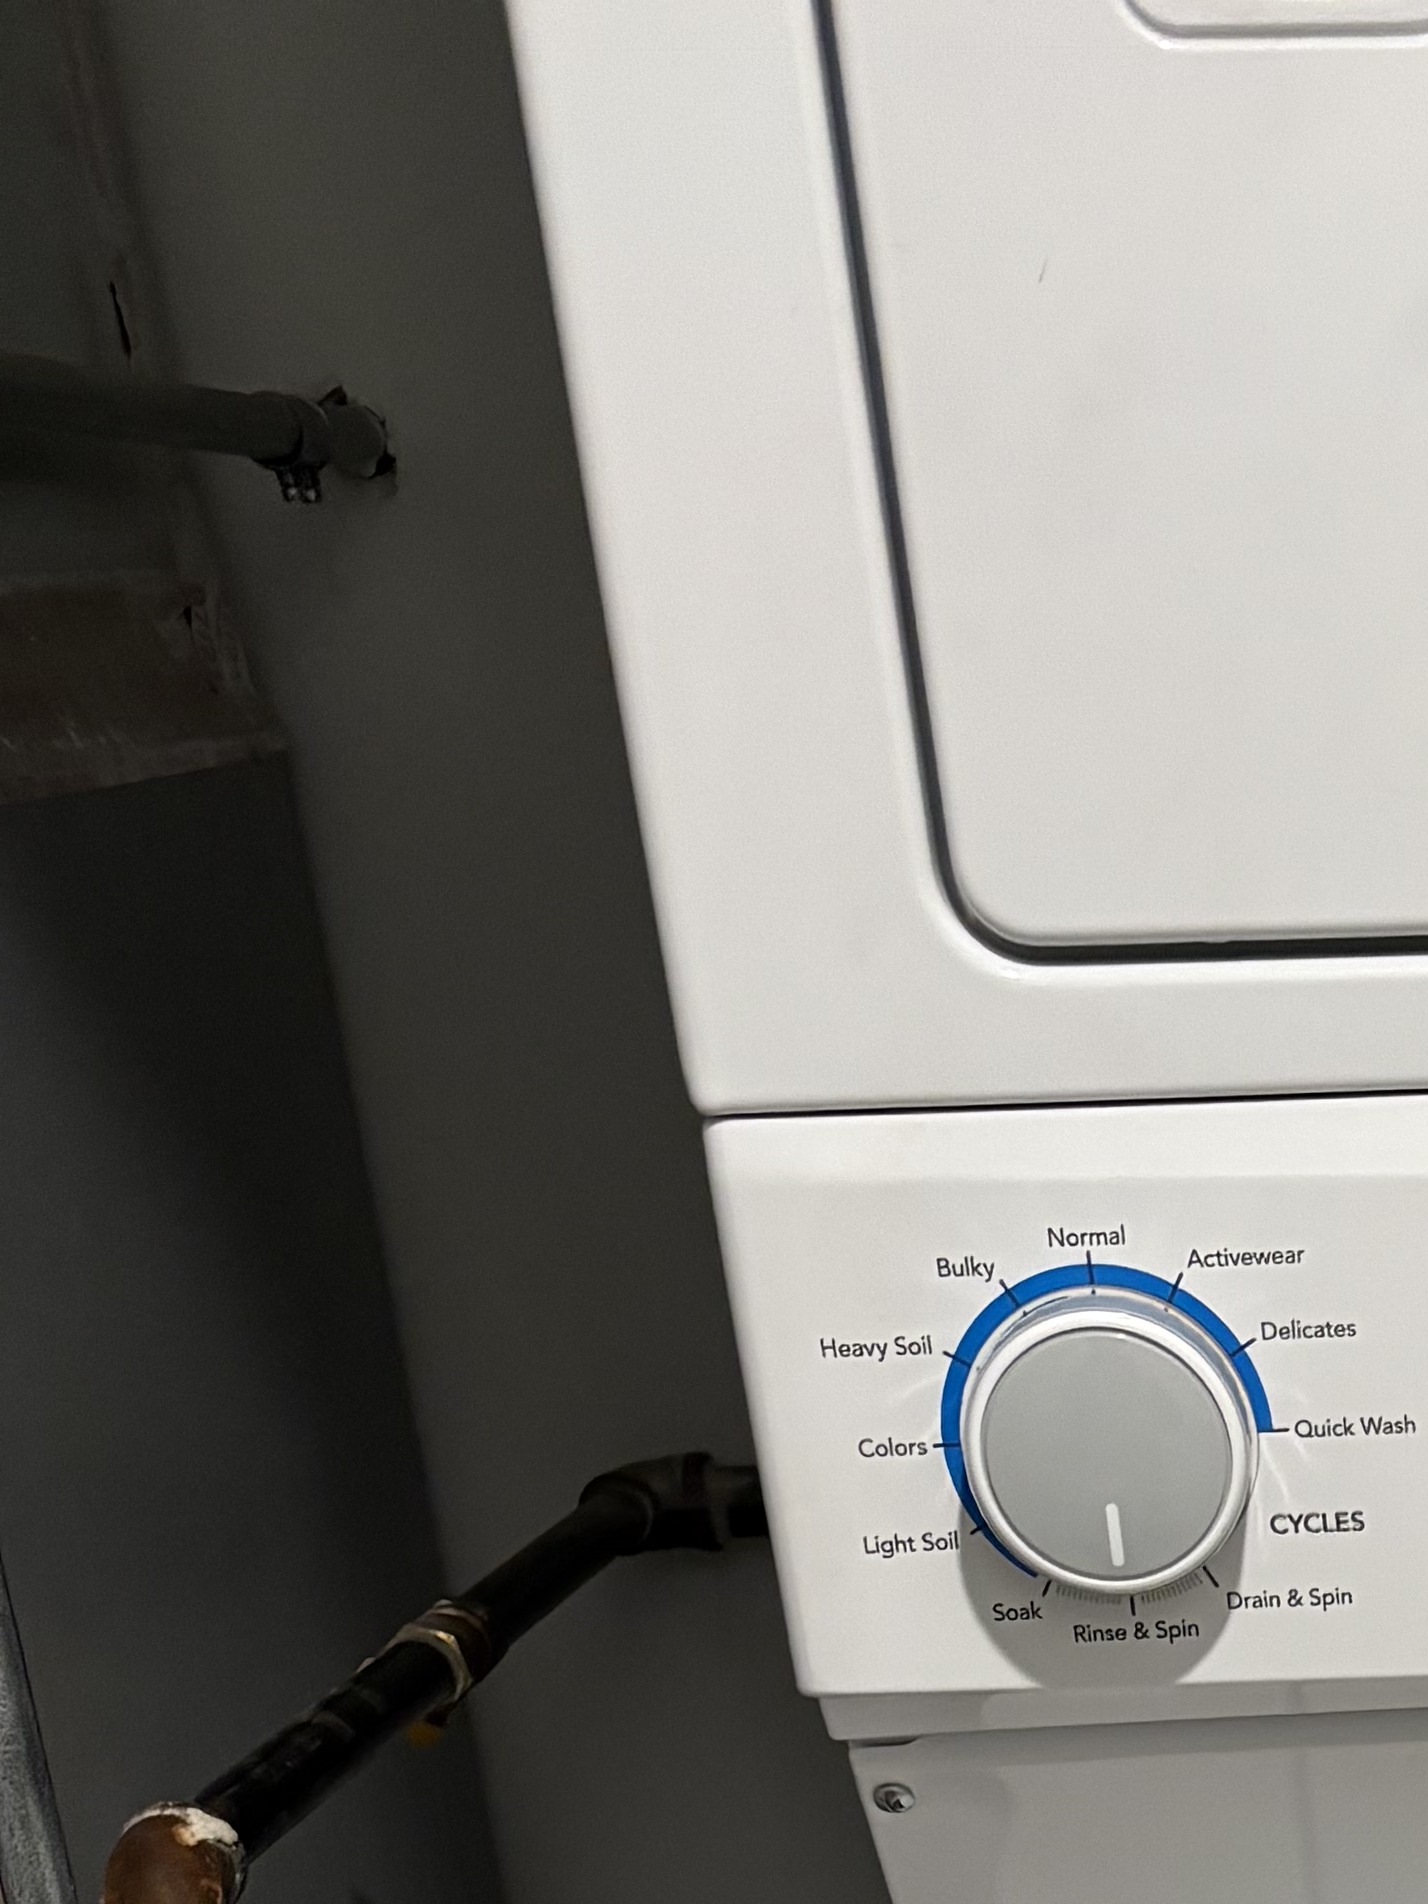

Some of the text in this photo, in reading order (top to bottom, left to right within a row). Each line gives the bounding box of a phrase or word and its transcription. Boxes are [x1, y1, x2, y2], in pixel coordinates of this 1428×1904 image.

[1047, 1226, 1125, 1247] Normal
[1187, 1248, 1305, 1269] Activewear
[936, 1258, 995, 1282] Bulky
[1261, 1321, 1357, 1342] Delicates
[820, 1336, 932, 1361] Heavy Soil
[1295, 1416, 1416, 1438] Quick Wash
[858, 1438, 928, 1458] Colors
[1270, 1512, 1365, 1535] CYCLES
[863, 1531, 959, 1559] Light Soil
[1227, 1587, 1353, 1612] Drain & Spin
[993, 1603, 1042, 1623] Soak
[1074, 1620, 1200, 1645] Rinse & Spin
